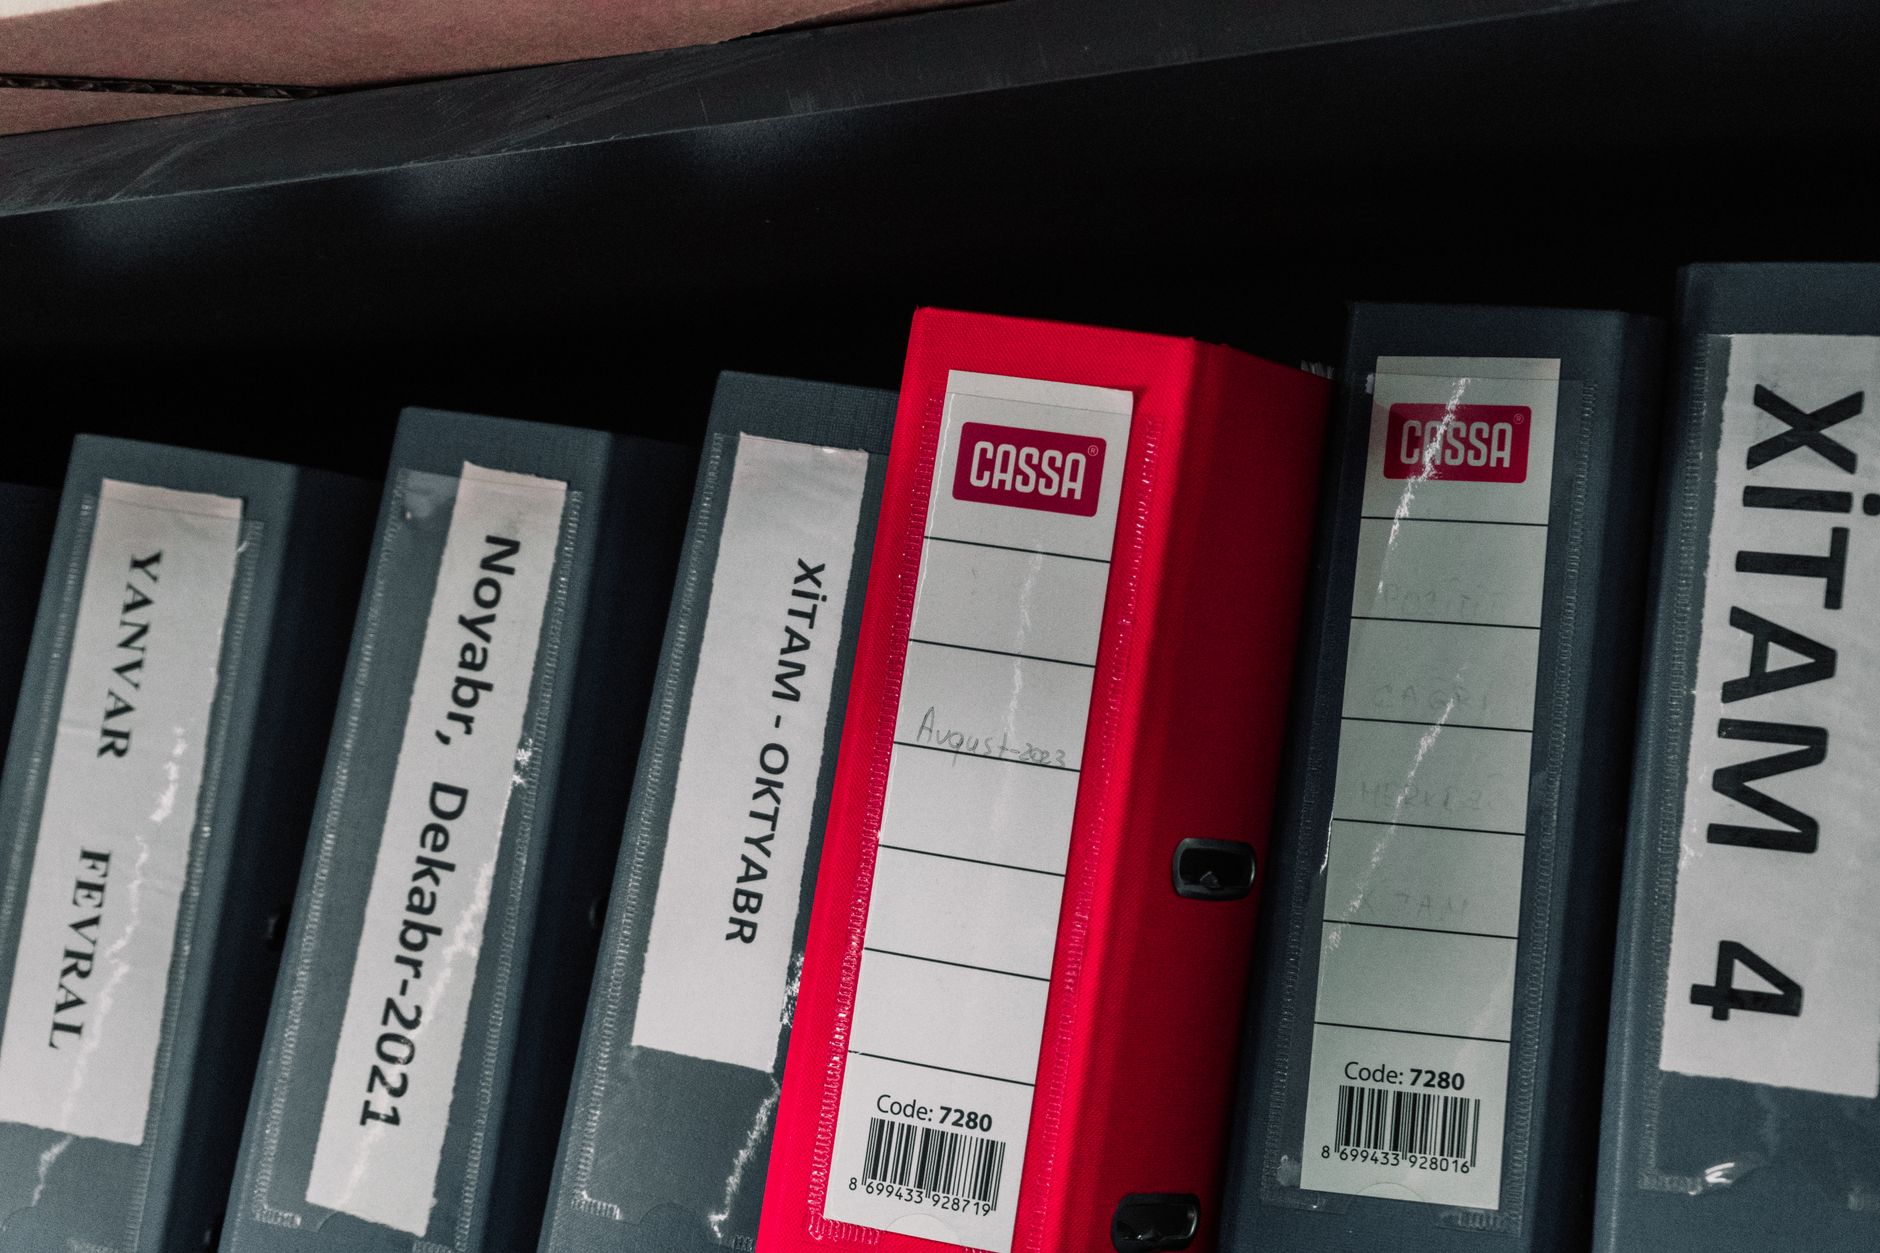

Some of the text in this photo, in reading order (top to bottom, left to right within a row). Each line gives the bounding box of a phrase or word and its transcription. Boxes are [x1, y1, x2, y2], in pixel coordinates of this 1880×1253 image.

[969, 440, 1087, 500] CASSA
[1400, 419, 1513, 468] CASSA
[48, 550, 164, 1050] YANVAR FEVRAL
[359, 534, 521, 1128] Noyabr, Dekabr-2021
[725, 742, 790, 944] OKTYABR
[1689, 939, 1804, 1022] 4
[1344, 1061, 1465, 1091] Code: 7280
[876, 1094, 993, 1132] Code: 7280
